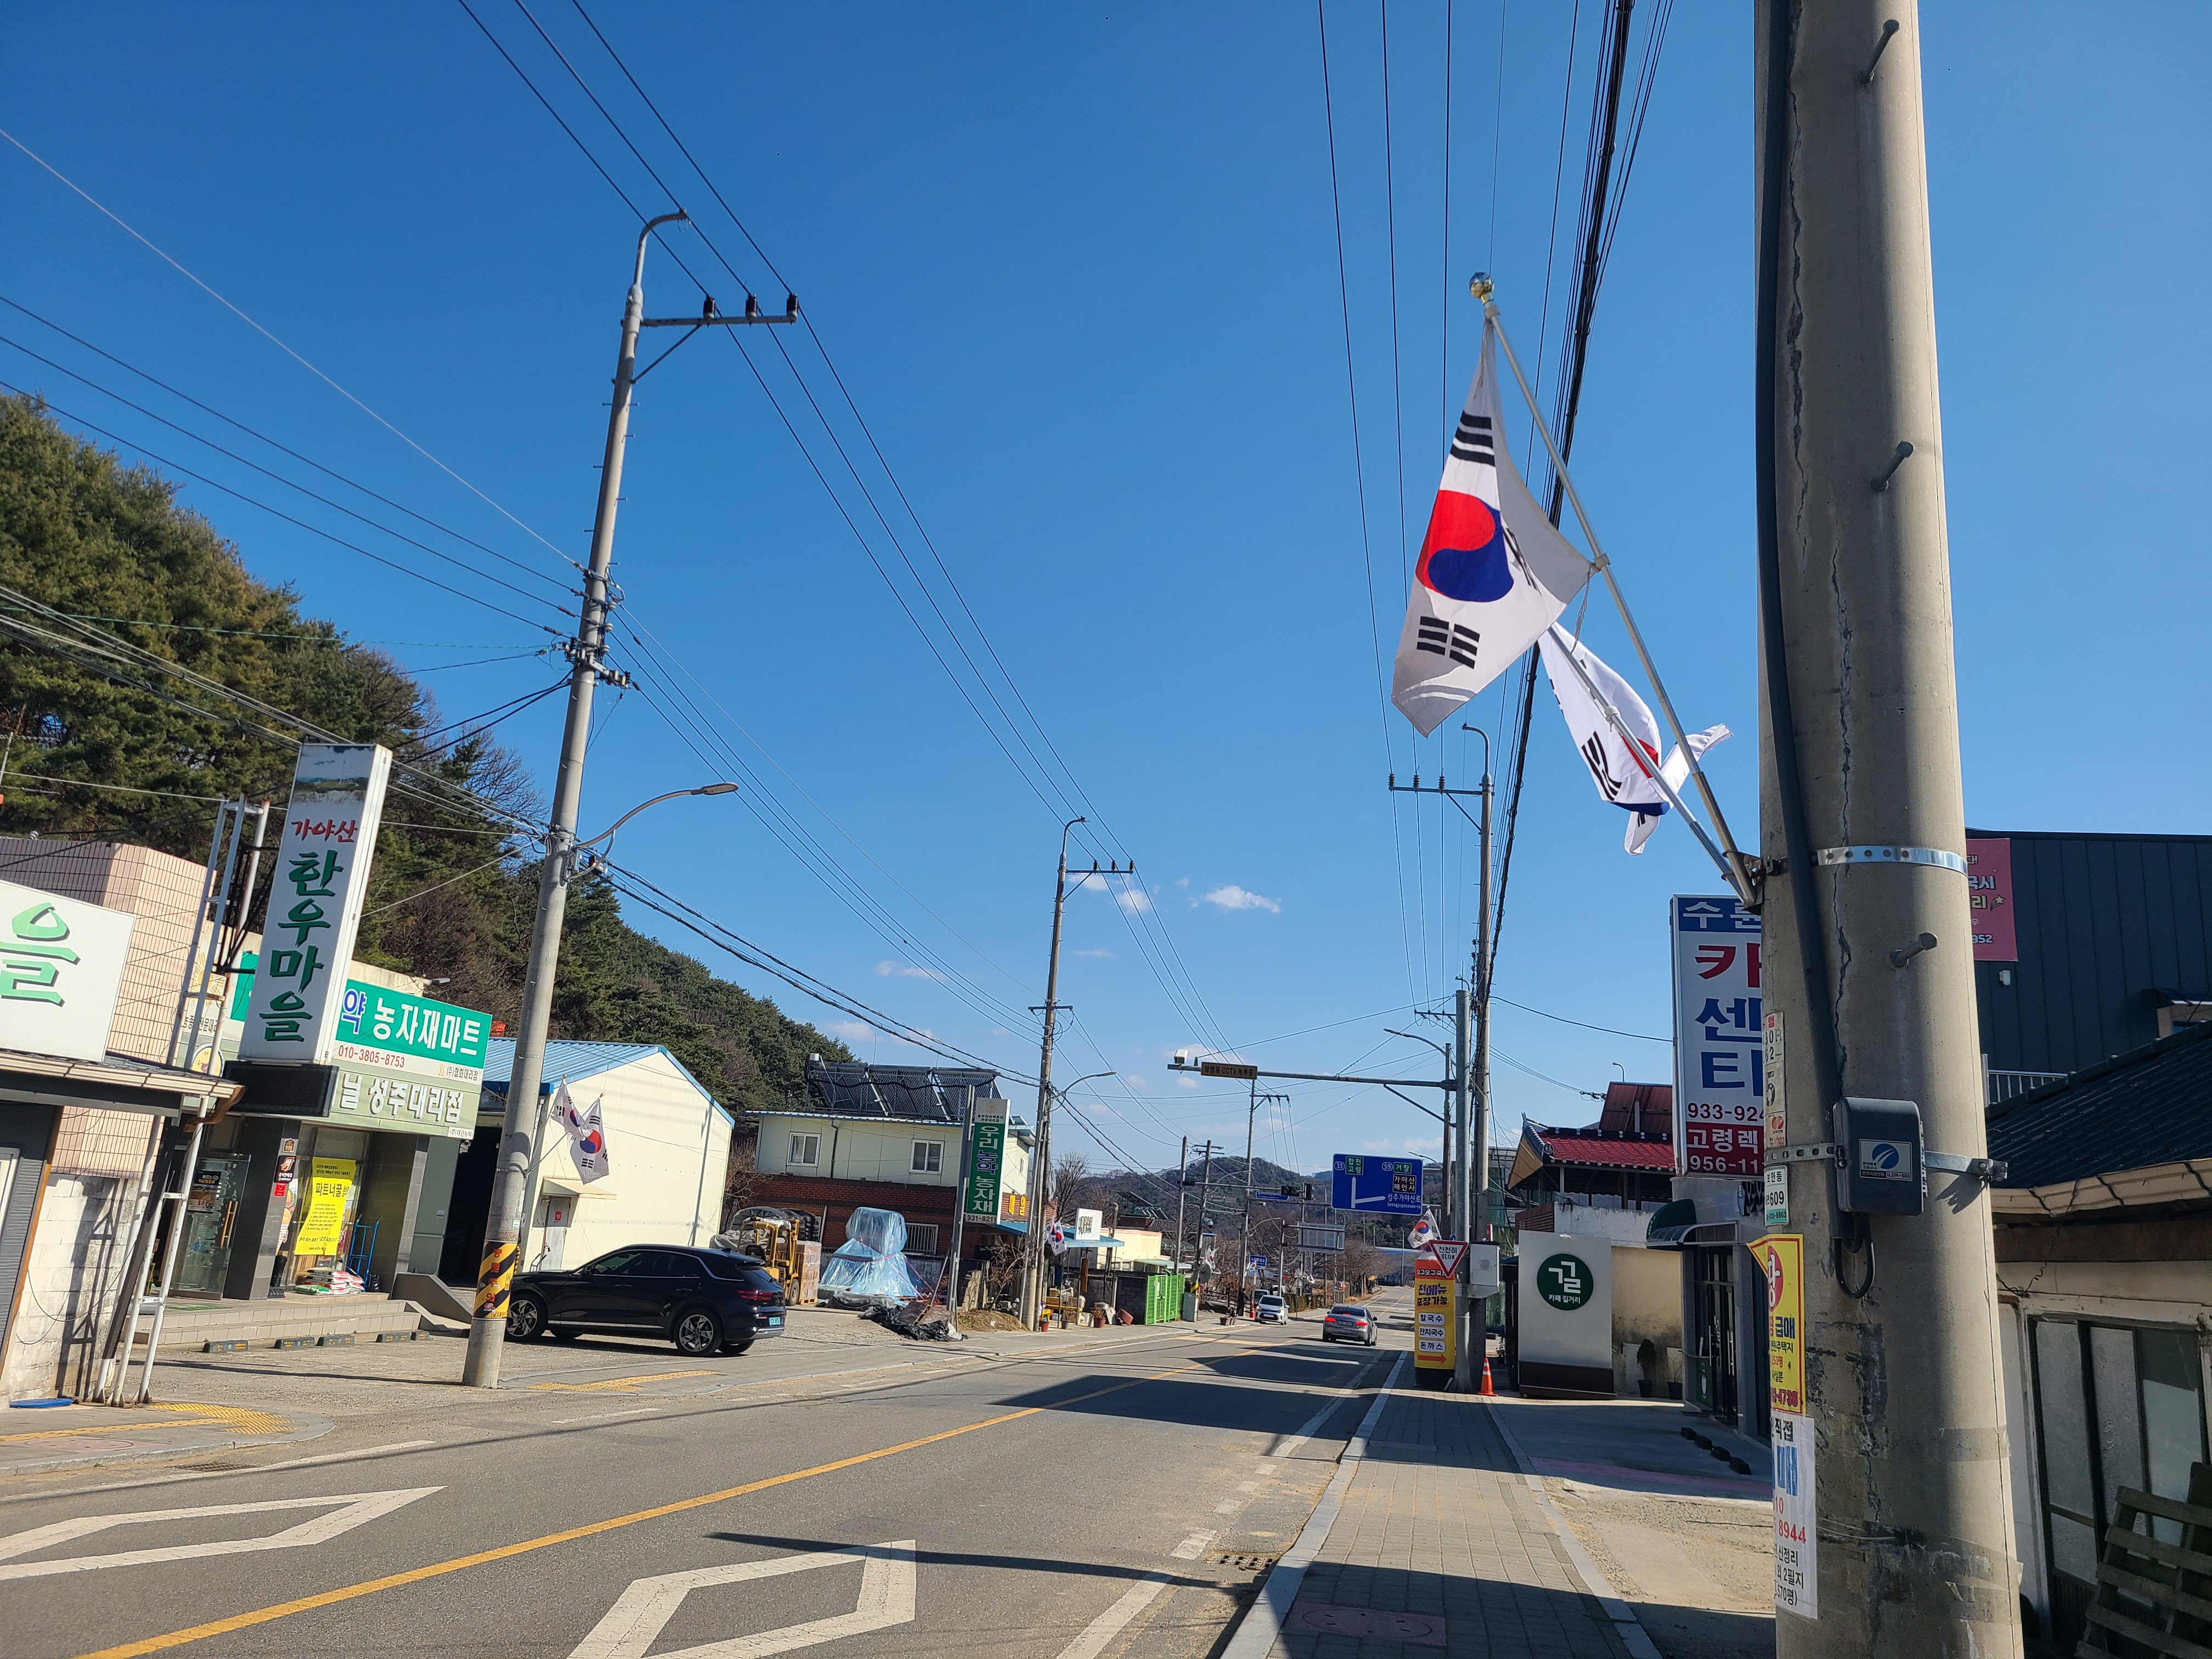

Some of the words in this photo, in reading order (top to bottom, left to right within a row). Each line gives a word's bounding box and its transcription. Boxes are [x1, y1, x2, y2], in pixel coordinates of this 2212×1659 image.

[291, 819, 358, 843] 가야산
[259, 849, 343, 1042] 한우마을
[1972, 934, 1994, 944] 952
[373, 997, 481, 1056] 농자재마트
[338, 1045, 405, 1068] 010-3805-8753
[1222, 1067, 1237, 1075] CCTV
[368, 1079, 464, 1123] 성주대리점
[1688, 1103, 1763, 1122] 933-92
[1687, 1128, 1758, 1154] 고령렉
[1396, 1164, 1410, 1172] 거창
[1394, 1176, 1415, 1184] 가야산
[1767, 1171, 1782, 1183] 보안등
[1393, 1183, 1415, 1192] 해인사
[1387, 1193, 1421, 1203] 성주가야산로
[1770, 1190, 1784, 1206] 609
[1418, 1283, 1447, 1296] 전메뉴
[1417, 1296, 1448, 1306] 포장가능
[1549, 1294, 1561, 1302] 카페
[1562, 1295, 1581, 1304] 길거리
[1420, 1313, 1443, 1323] 칼국수
[1419, 1328, 1444, 1336] 잔치국수
[1775, 1316, 1795, 1339] 급매
[1420, 1342, 1443, 1350] 돈까스
[1779, 1519, 1807, 1544] 8944
[1778, 1547, 1798, 1567] 신정리
[1784, 1567, 1804, 1589] 2필지
